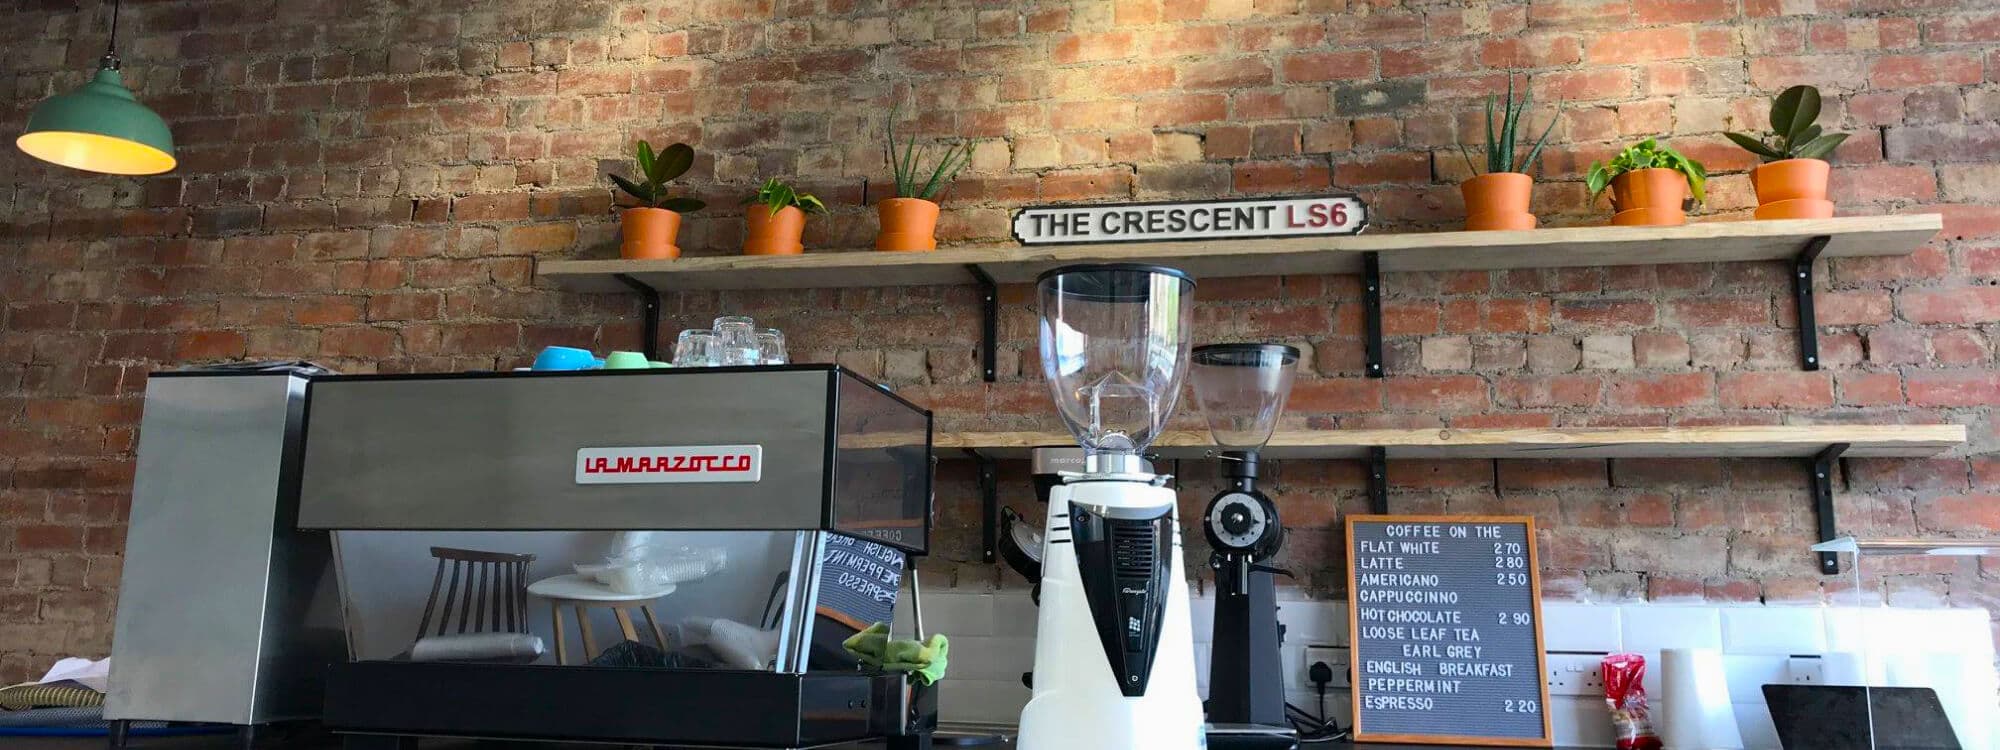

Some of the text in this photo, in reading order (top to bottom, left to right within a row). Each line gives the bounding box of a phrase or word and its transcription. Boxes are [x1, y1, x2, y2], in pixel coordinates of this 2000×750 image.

[1030, 203, 1347, 236] THE CRESCENT LS6
[585, 457, 608, 473] LA
[1386, 525, 1502, 538] COFFEE ON THE
[1360, 541, 1394, 553] FLAT
[1399, 541, 1440, 555] WHITE
[1360, 557, 1404, 569] LATTE
[1360, 573, 1439, 587] AMERICANO
[1359, 590, 1458, 604] CAPPUCCINNO
[1362, 626, 1480, 642] LOOSE LEAF TEA
[1402, 644, 1482, 659] EARL GREY
[1366, 661, 1514, 677] ENGLISH BREAKFAST
[1368, 678, 1462, 693] PEPPERMINT
[1365, 695, 1434, 711] ESPRESSO
